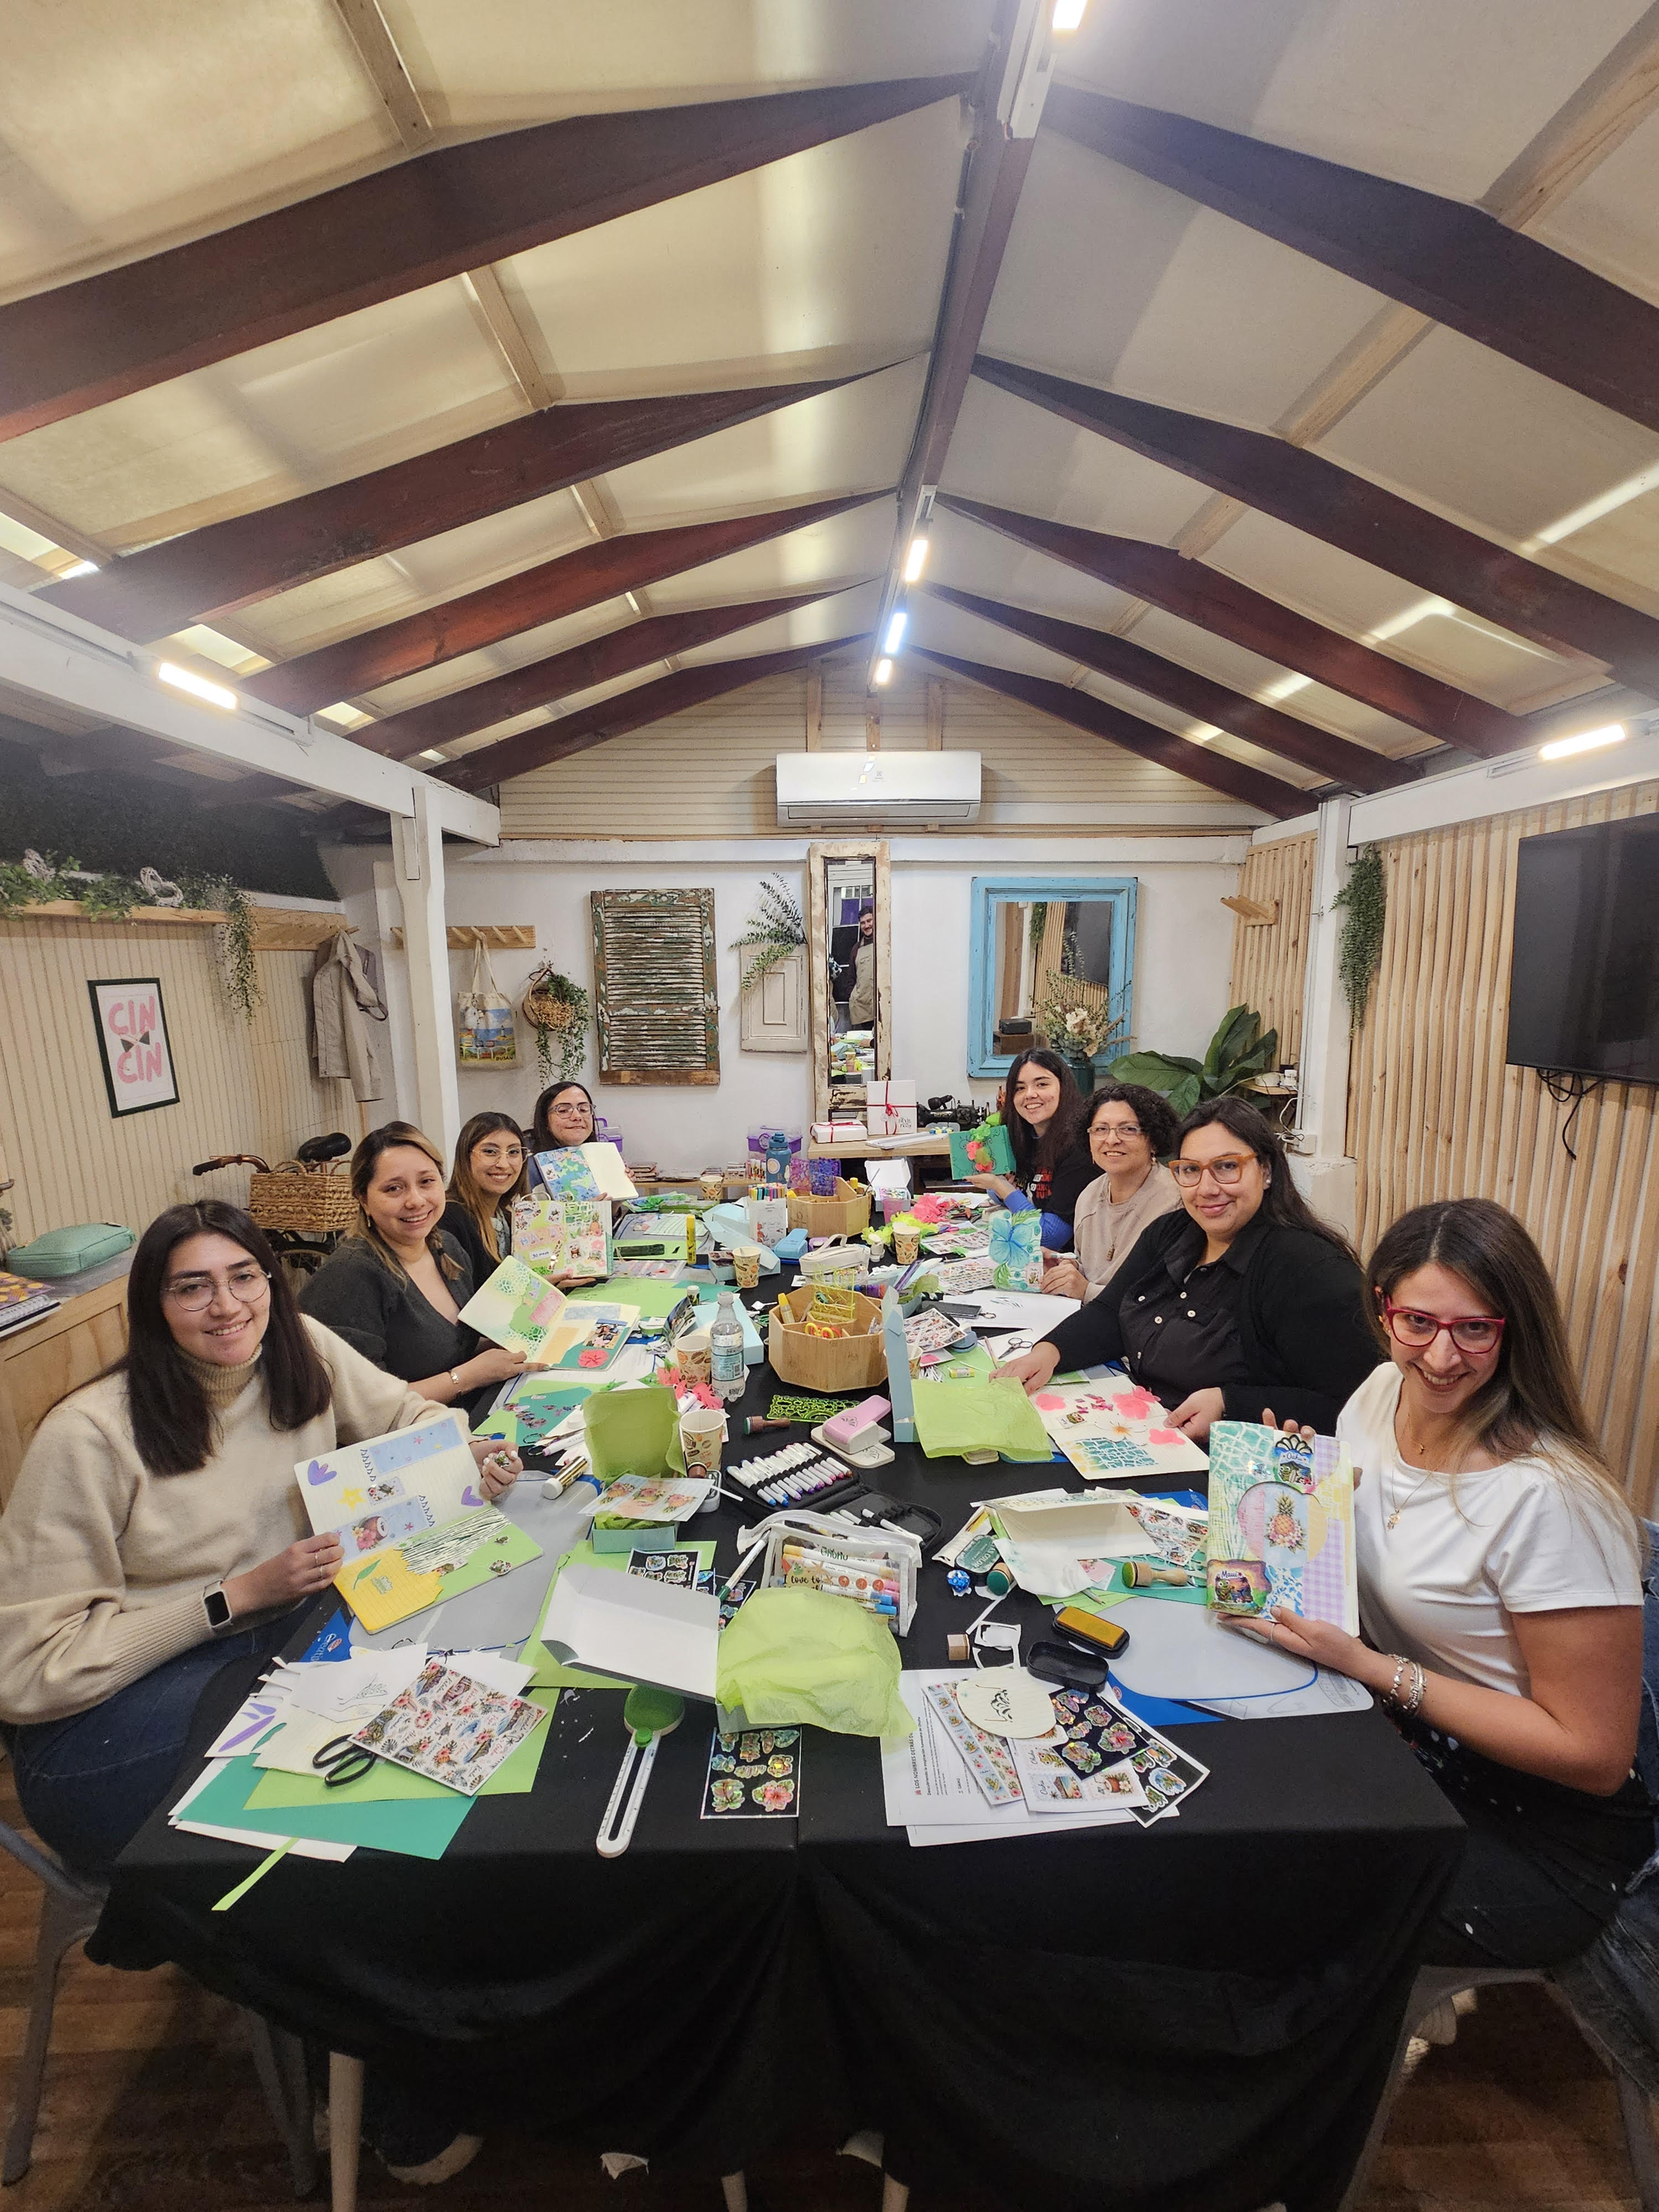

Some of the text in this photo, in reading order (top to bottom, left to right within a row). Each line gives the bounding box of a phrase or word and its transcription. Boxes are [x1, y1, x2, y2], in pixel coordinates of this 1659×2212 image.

[108, 996, 155, 1035] CIN
[117, 1042, 162, 1083] CIN
[783, 1574, 821, 1584] I love to
